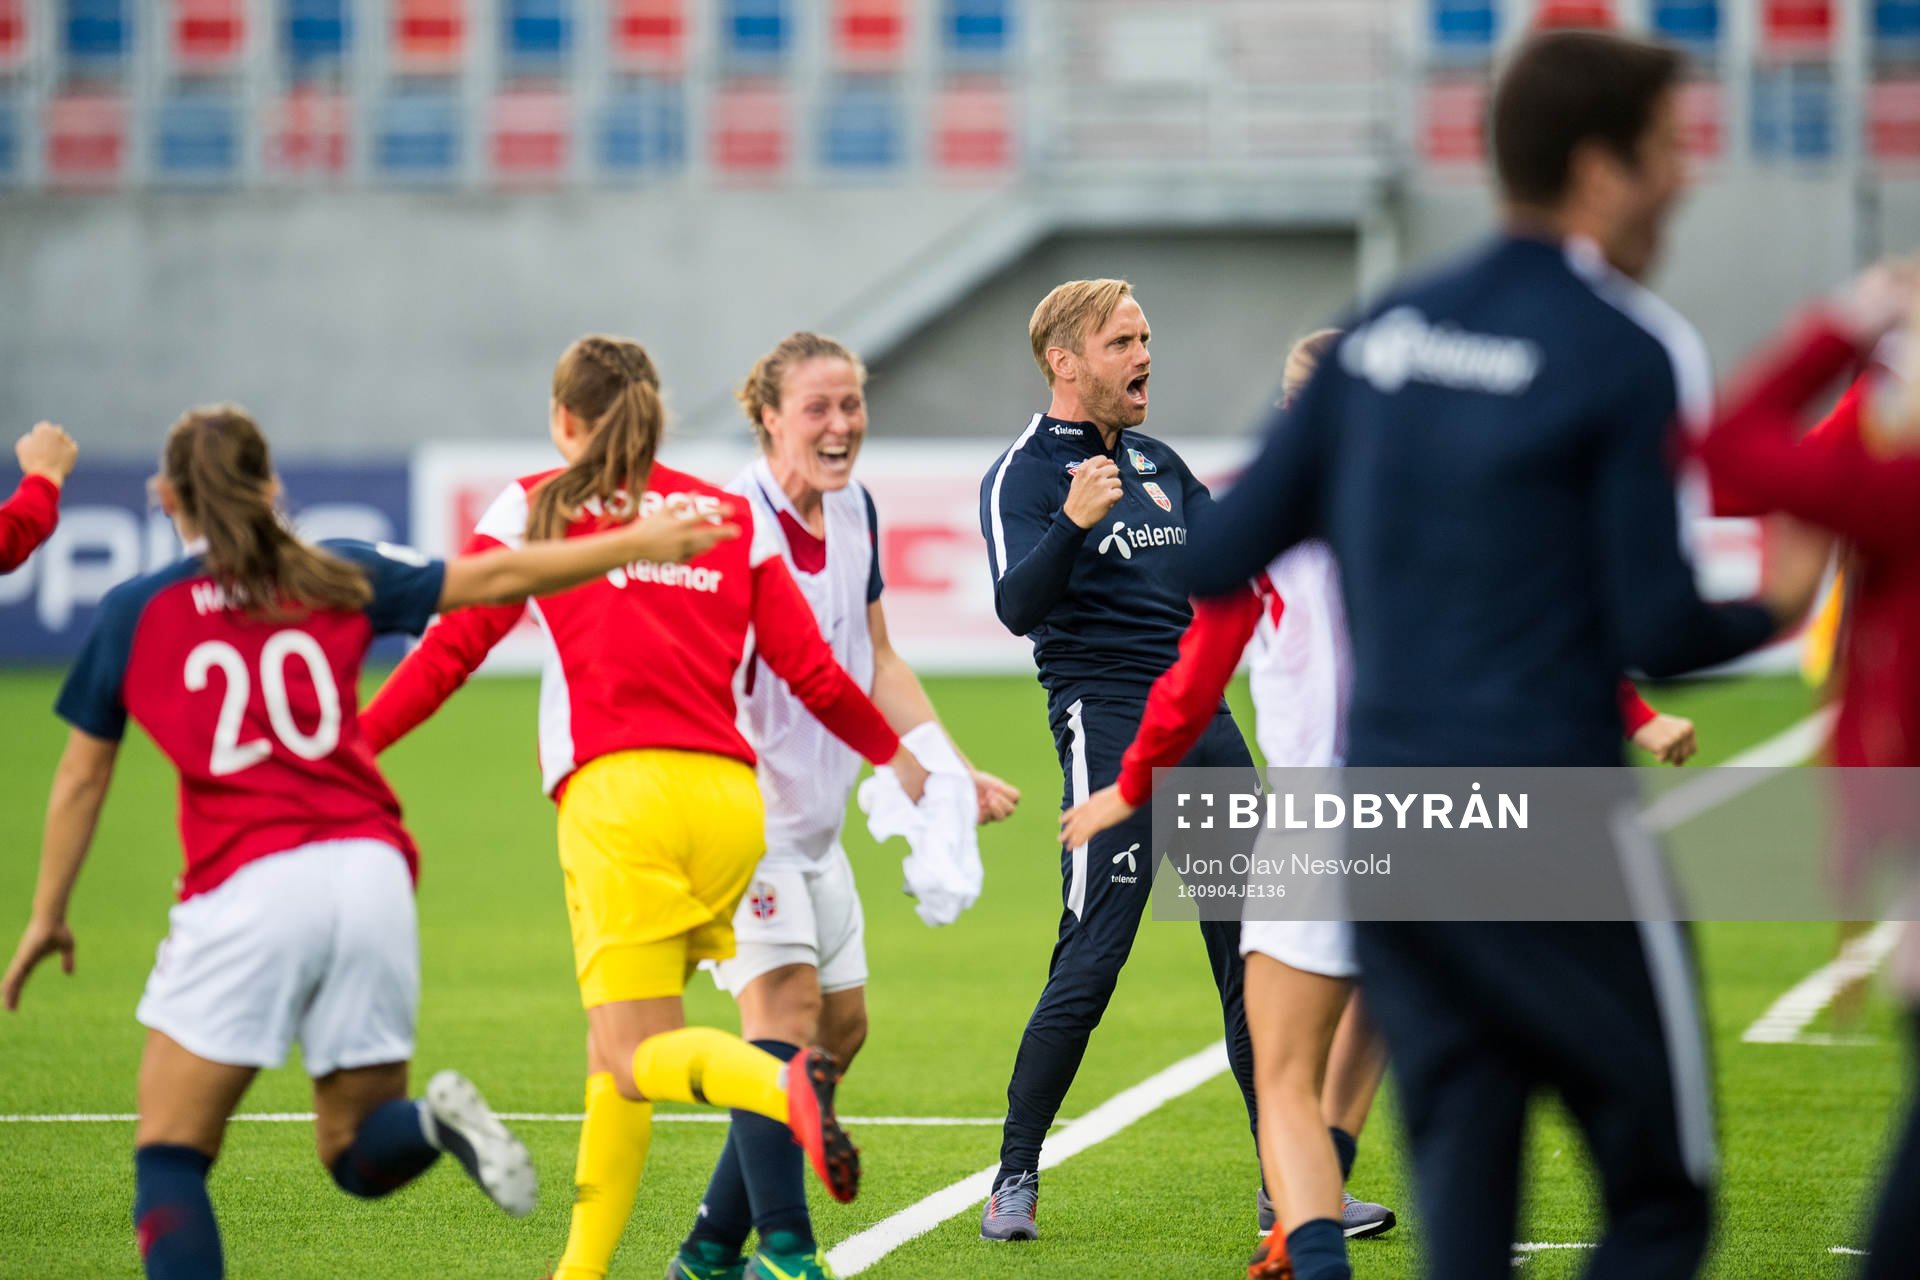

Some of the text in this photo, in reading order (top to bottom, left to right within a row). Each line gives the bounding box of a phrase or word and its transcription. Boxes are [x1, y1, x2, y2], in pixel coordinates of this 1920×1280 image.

[1127, 523, 1187, 549] telenor
[183, 629, 341, 776] 20
[1111, 874, 1138, 884] telenor
